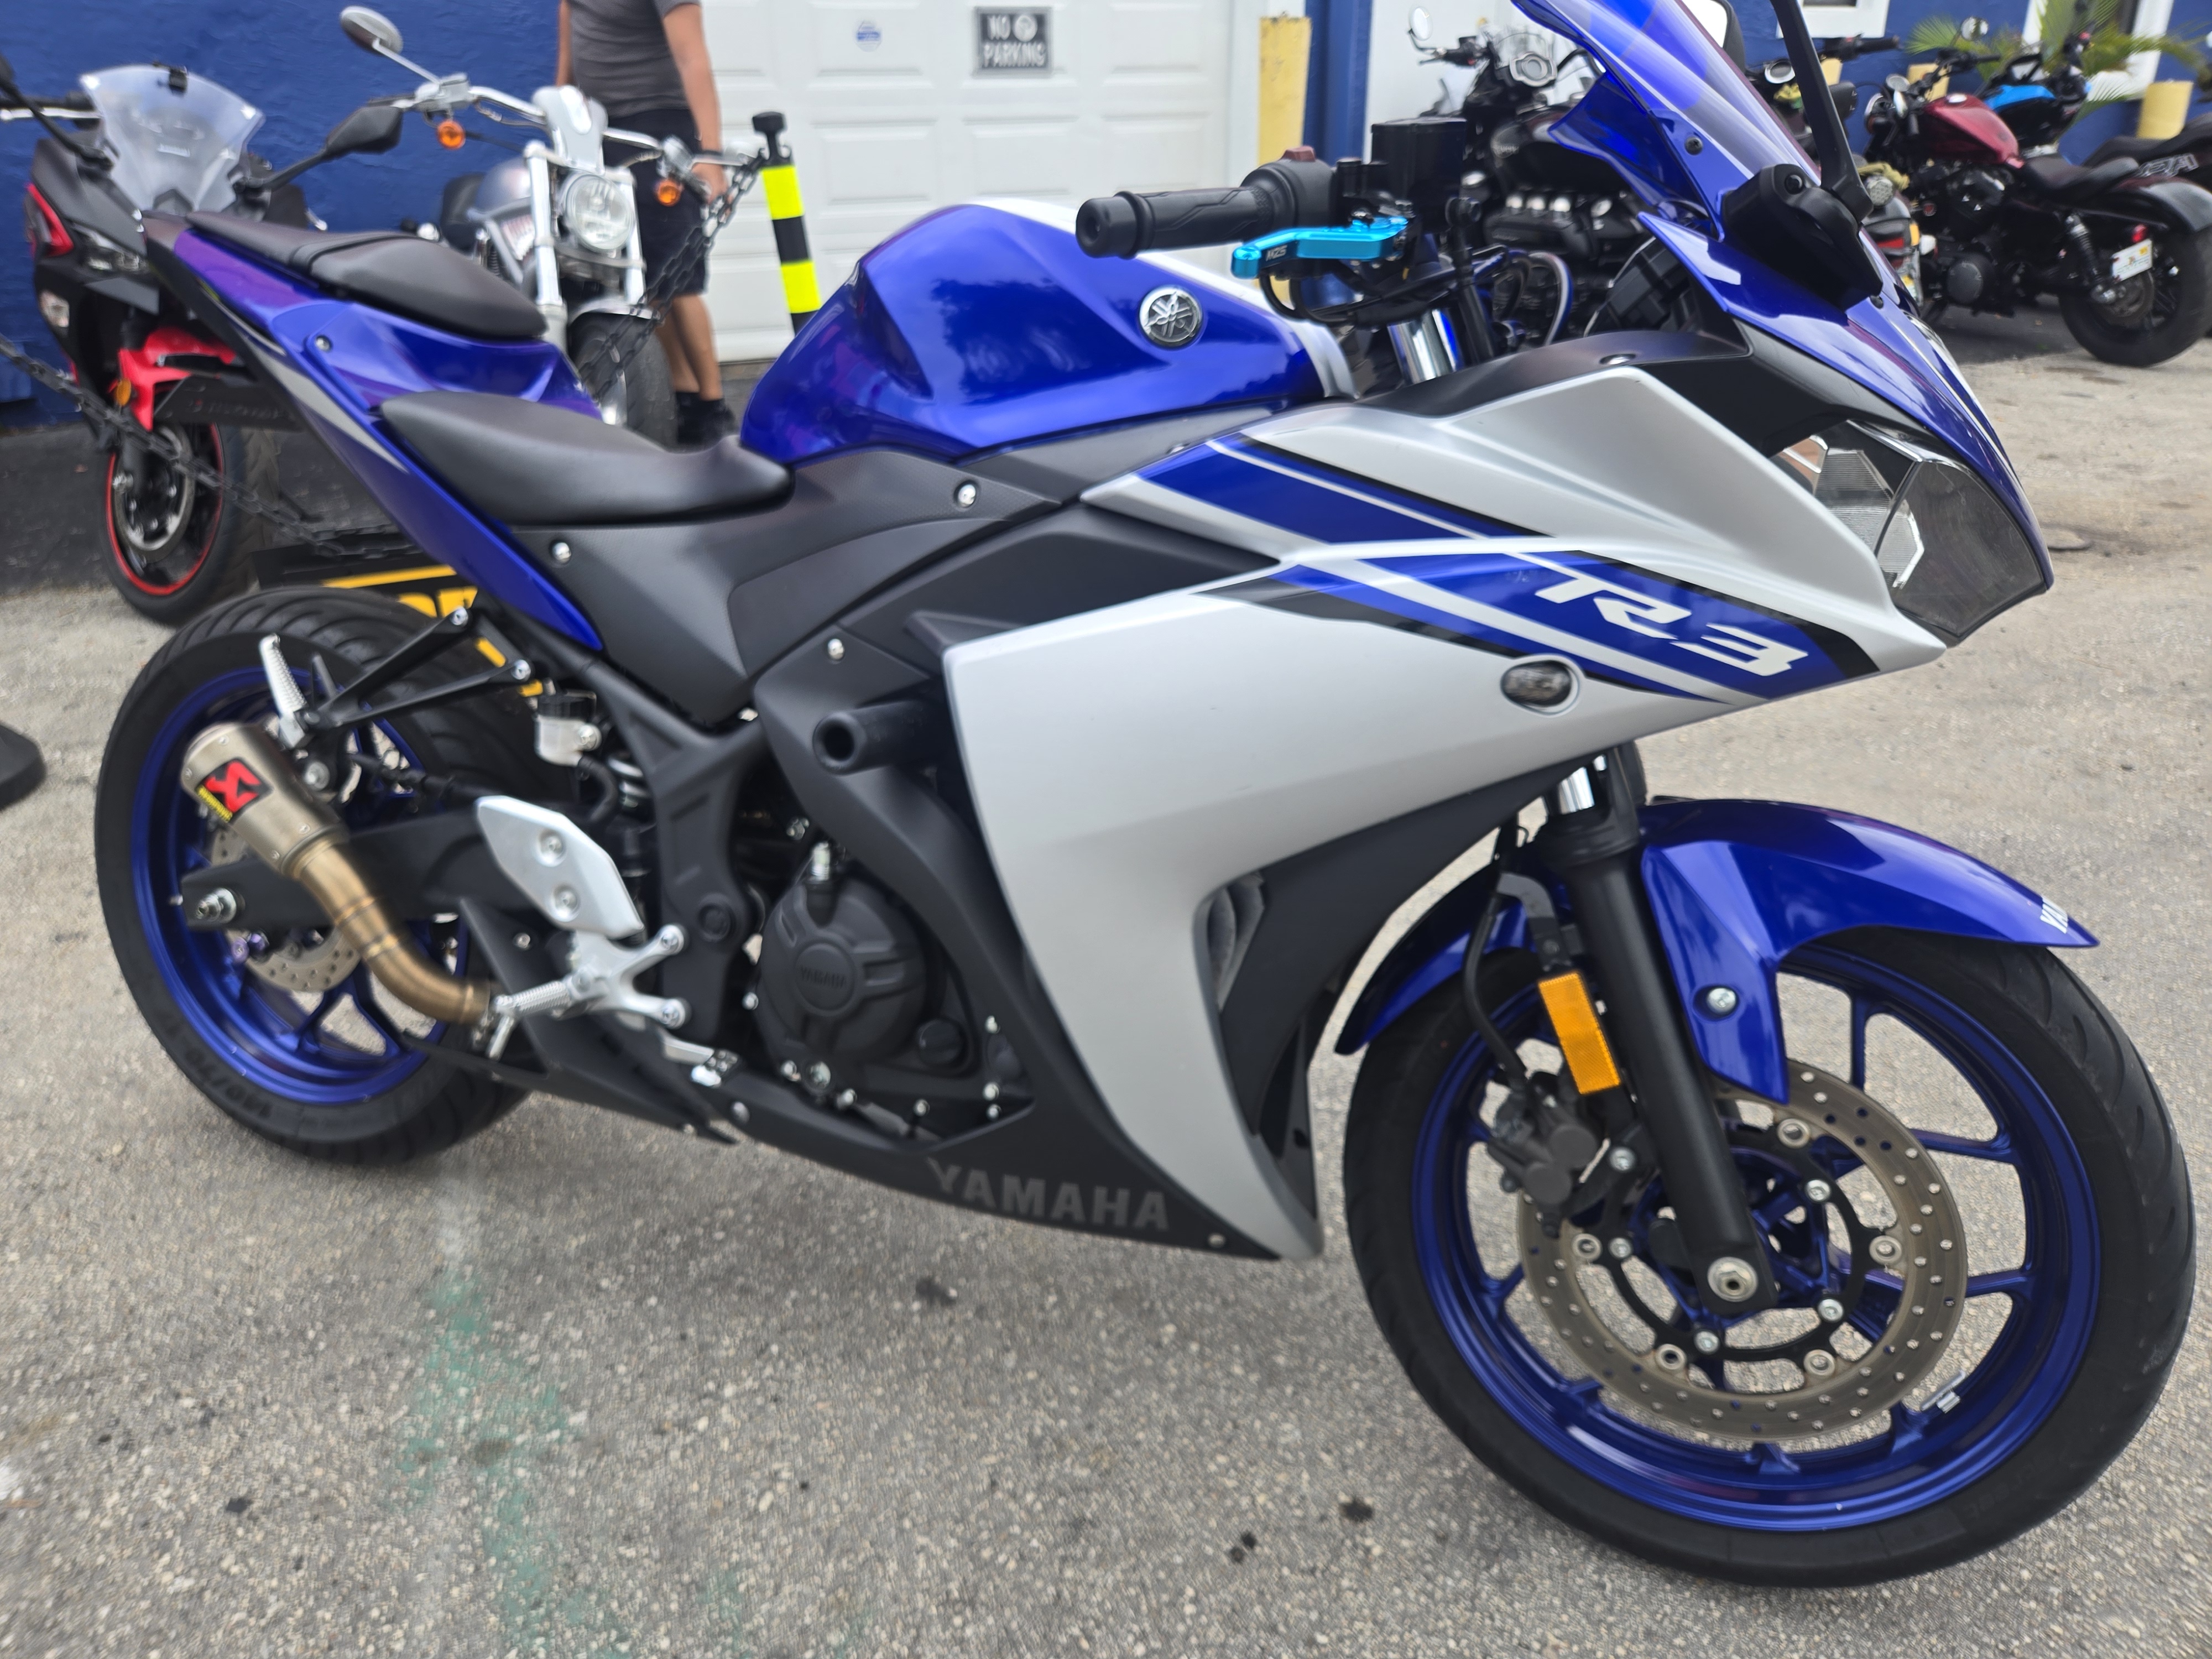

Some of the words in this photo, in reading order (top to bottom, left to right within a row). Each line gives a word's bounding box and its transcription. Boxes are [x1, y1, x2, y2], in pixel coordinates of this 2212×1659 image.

[987, 14, 1011, 40] NO
[983, 41, 1046, 67] PARKING
[927, 1156, 1170, 1232] YAMAHA
